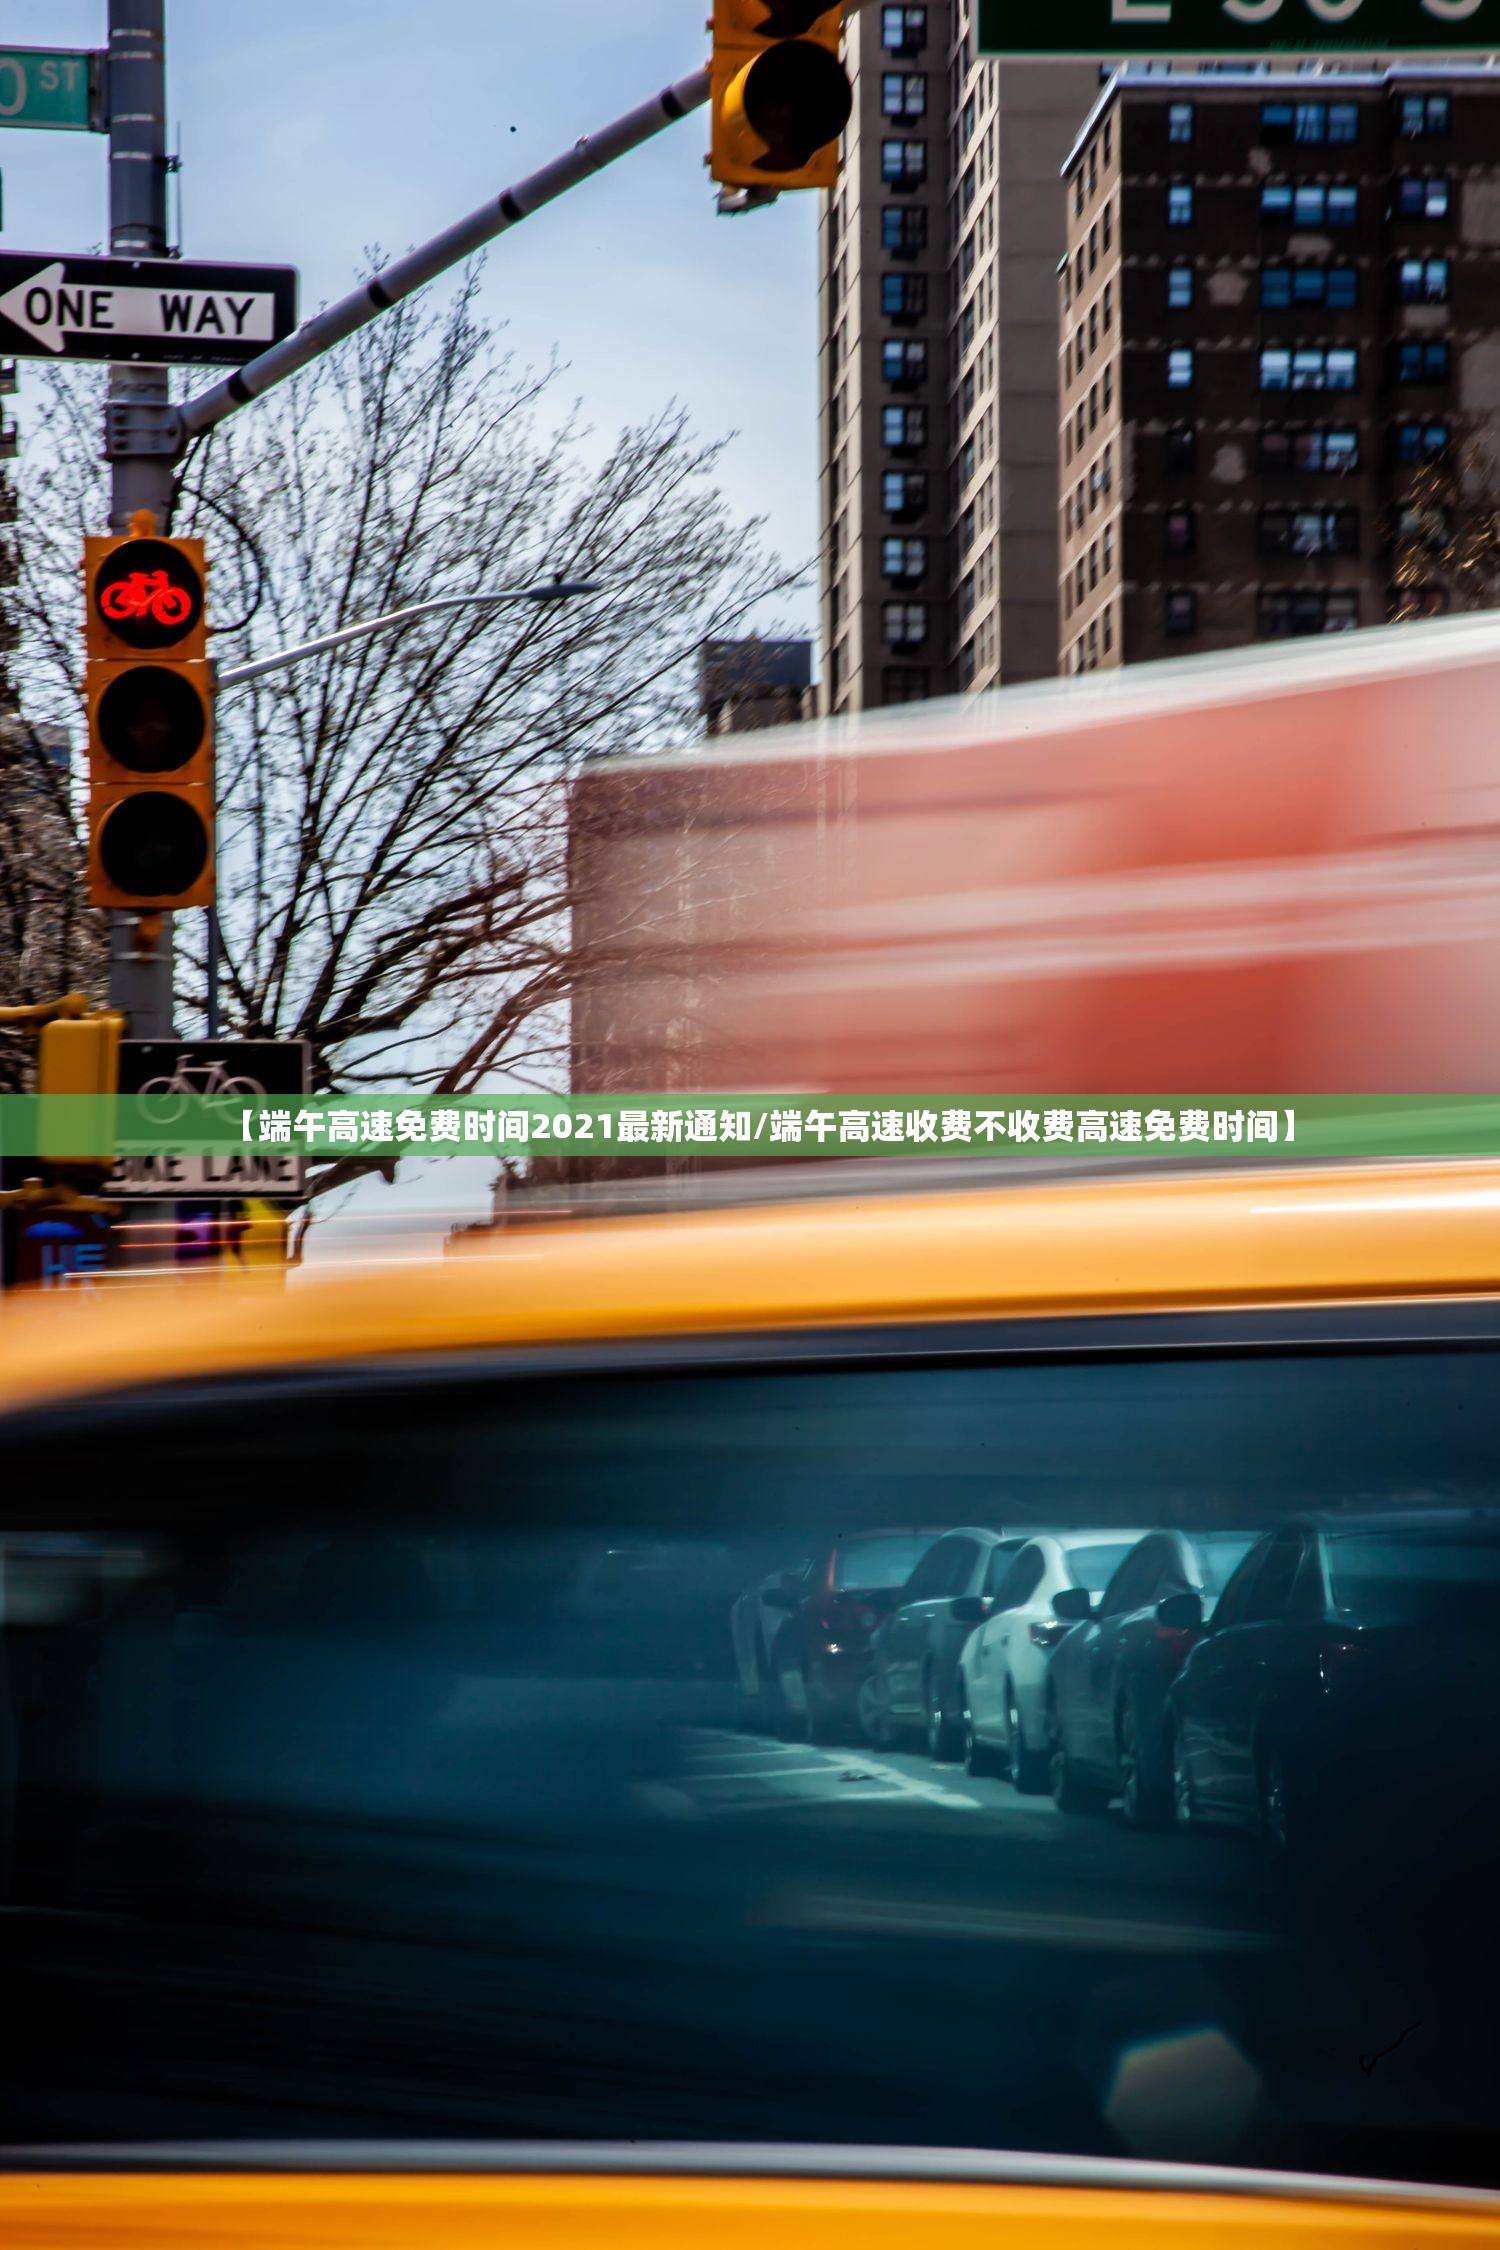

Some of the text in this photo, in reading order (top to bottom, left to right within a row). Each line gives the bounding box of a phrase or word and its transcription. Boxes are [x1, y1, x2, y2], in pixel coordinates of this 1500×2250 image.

[38, 59, 80, 92] ST
[25, 286, 255, 335] ONE WAY
[203, 1147, 293, 1182] LANE
